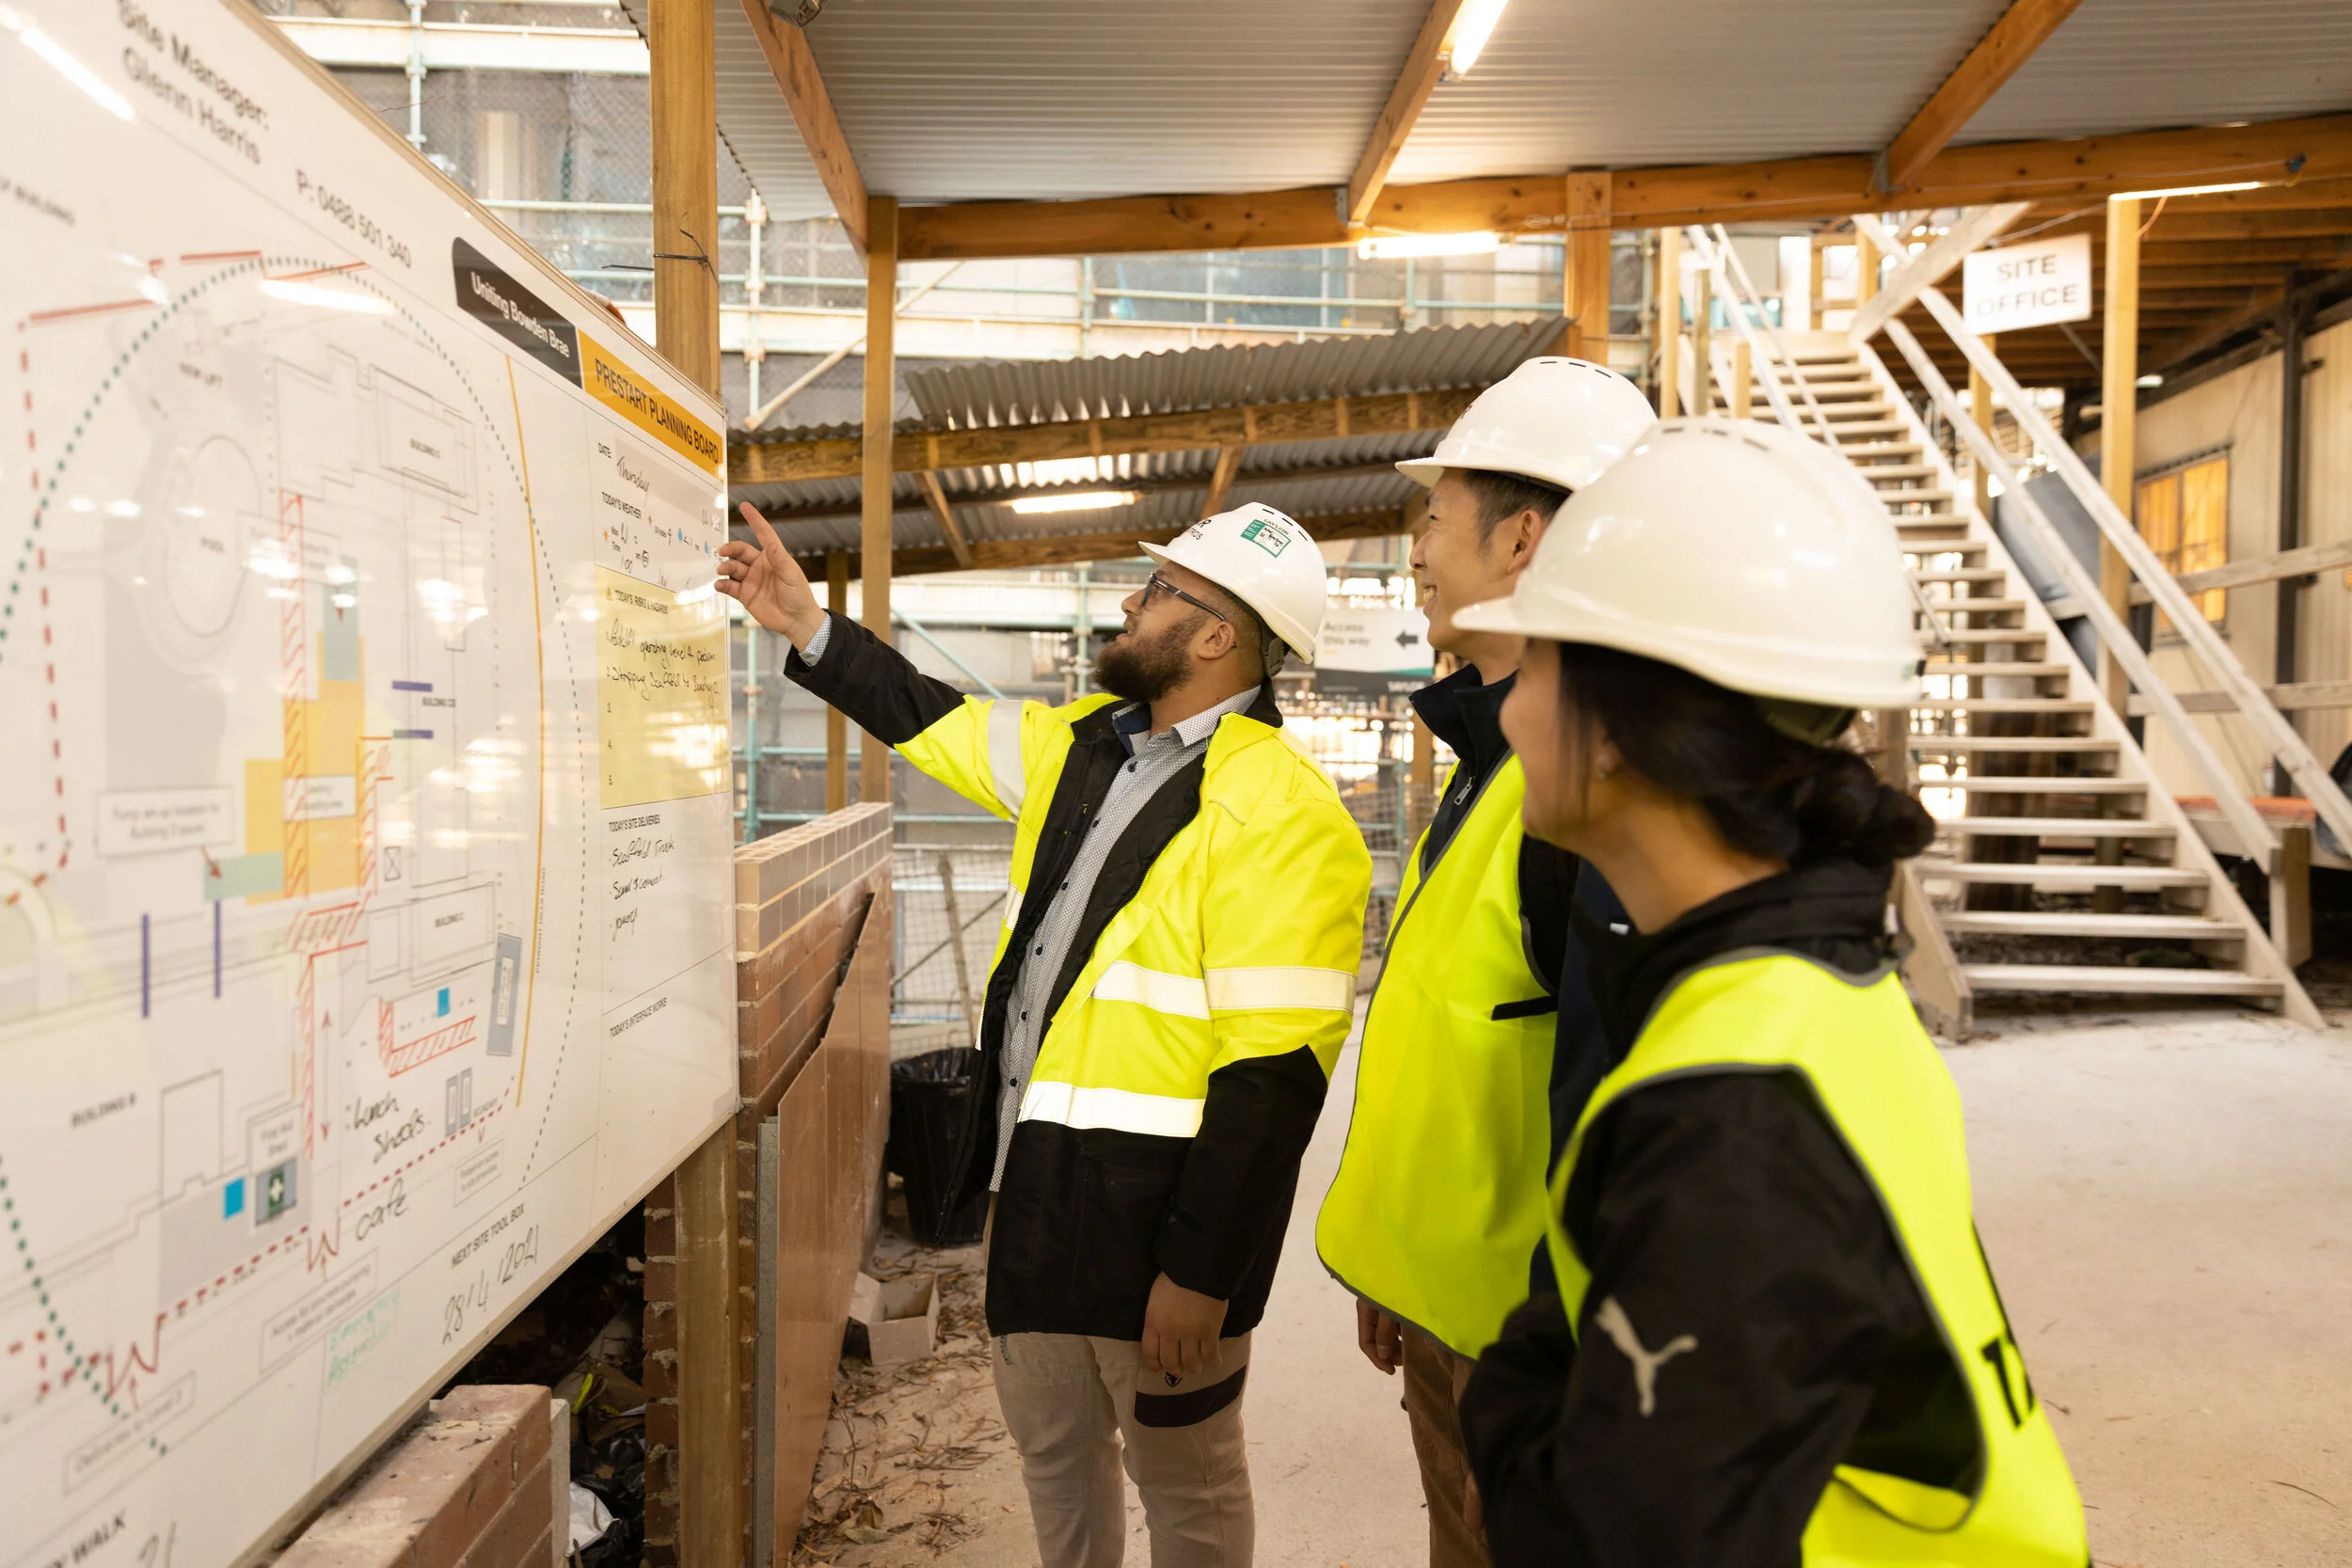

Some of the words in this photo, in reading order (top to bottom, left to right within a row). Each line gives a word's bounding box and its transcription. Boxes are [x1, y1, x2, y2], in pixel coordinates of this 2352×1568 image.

[119, 0, 164, 53] Site
[170, 33, 269, 131] Manager:
[123, 47, 193, 119] Glenn
[198, 98, 261, 165] Harris
[358, 214, 383, 250] 501
[388, 234, 412, 268] 340
[1996, 253, 2058, 282] SITE
[471, 272, 510, 320] Uniting
[509, 299, 548, 344] Bowden
[549, 329, 570, 358] Brae
[1977, 283, 2078, 317] OFFICE
[595, 357, 648, 415] PRESTART
[649, 398, 692, 446] PLANNING
[693, 430, 719, 464] BOARD
[616, 455, 650, 508] Thursday
[622, 501, 643, 520] WEATHER
[1263, 518, 1289, 535] TAYLOR
[614, 590, 633, 605] TODAY'S
[1323, 622, 1364, 633] Access
[1323, 635, 1345, 646] this
[1347, 636, 1371, 648] way
[609, 819, 628, 833] TODAY'S
[628, 817, 638, 830] SITE
[638, 814, 660, 827] DELIVERIES
[610, 1019, 629, 1039] TODAY'S
[629, 1006, 652, 1028] INTERFACE
[653, 997, 667, 1014] WORKS
[451, 1242, 472, 1269] NEXT
[472, 1229, 489, 1252] SITE
[491, 1215, 509, 1238] TOOL
[510, 1202, 525, 1223] BOX
